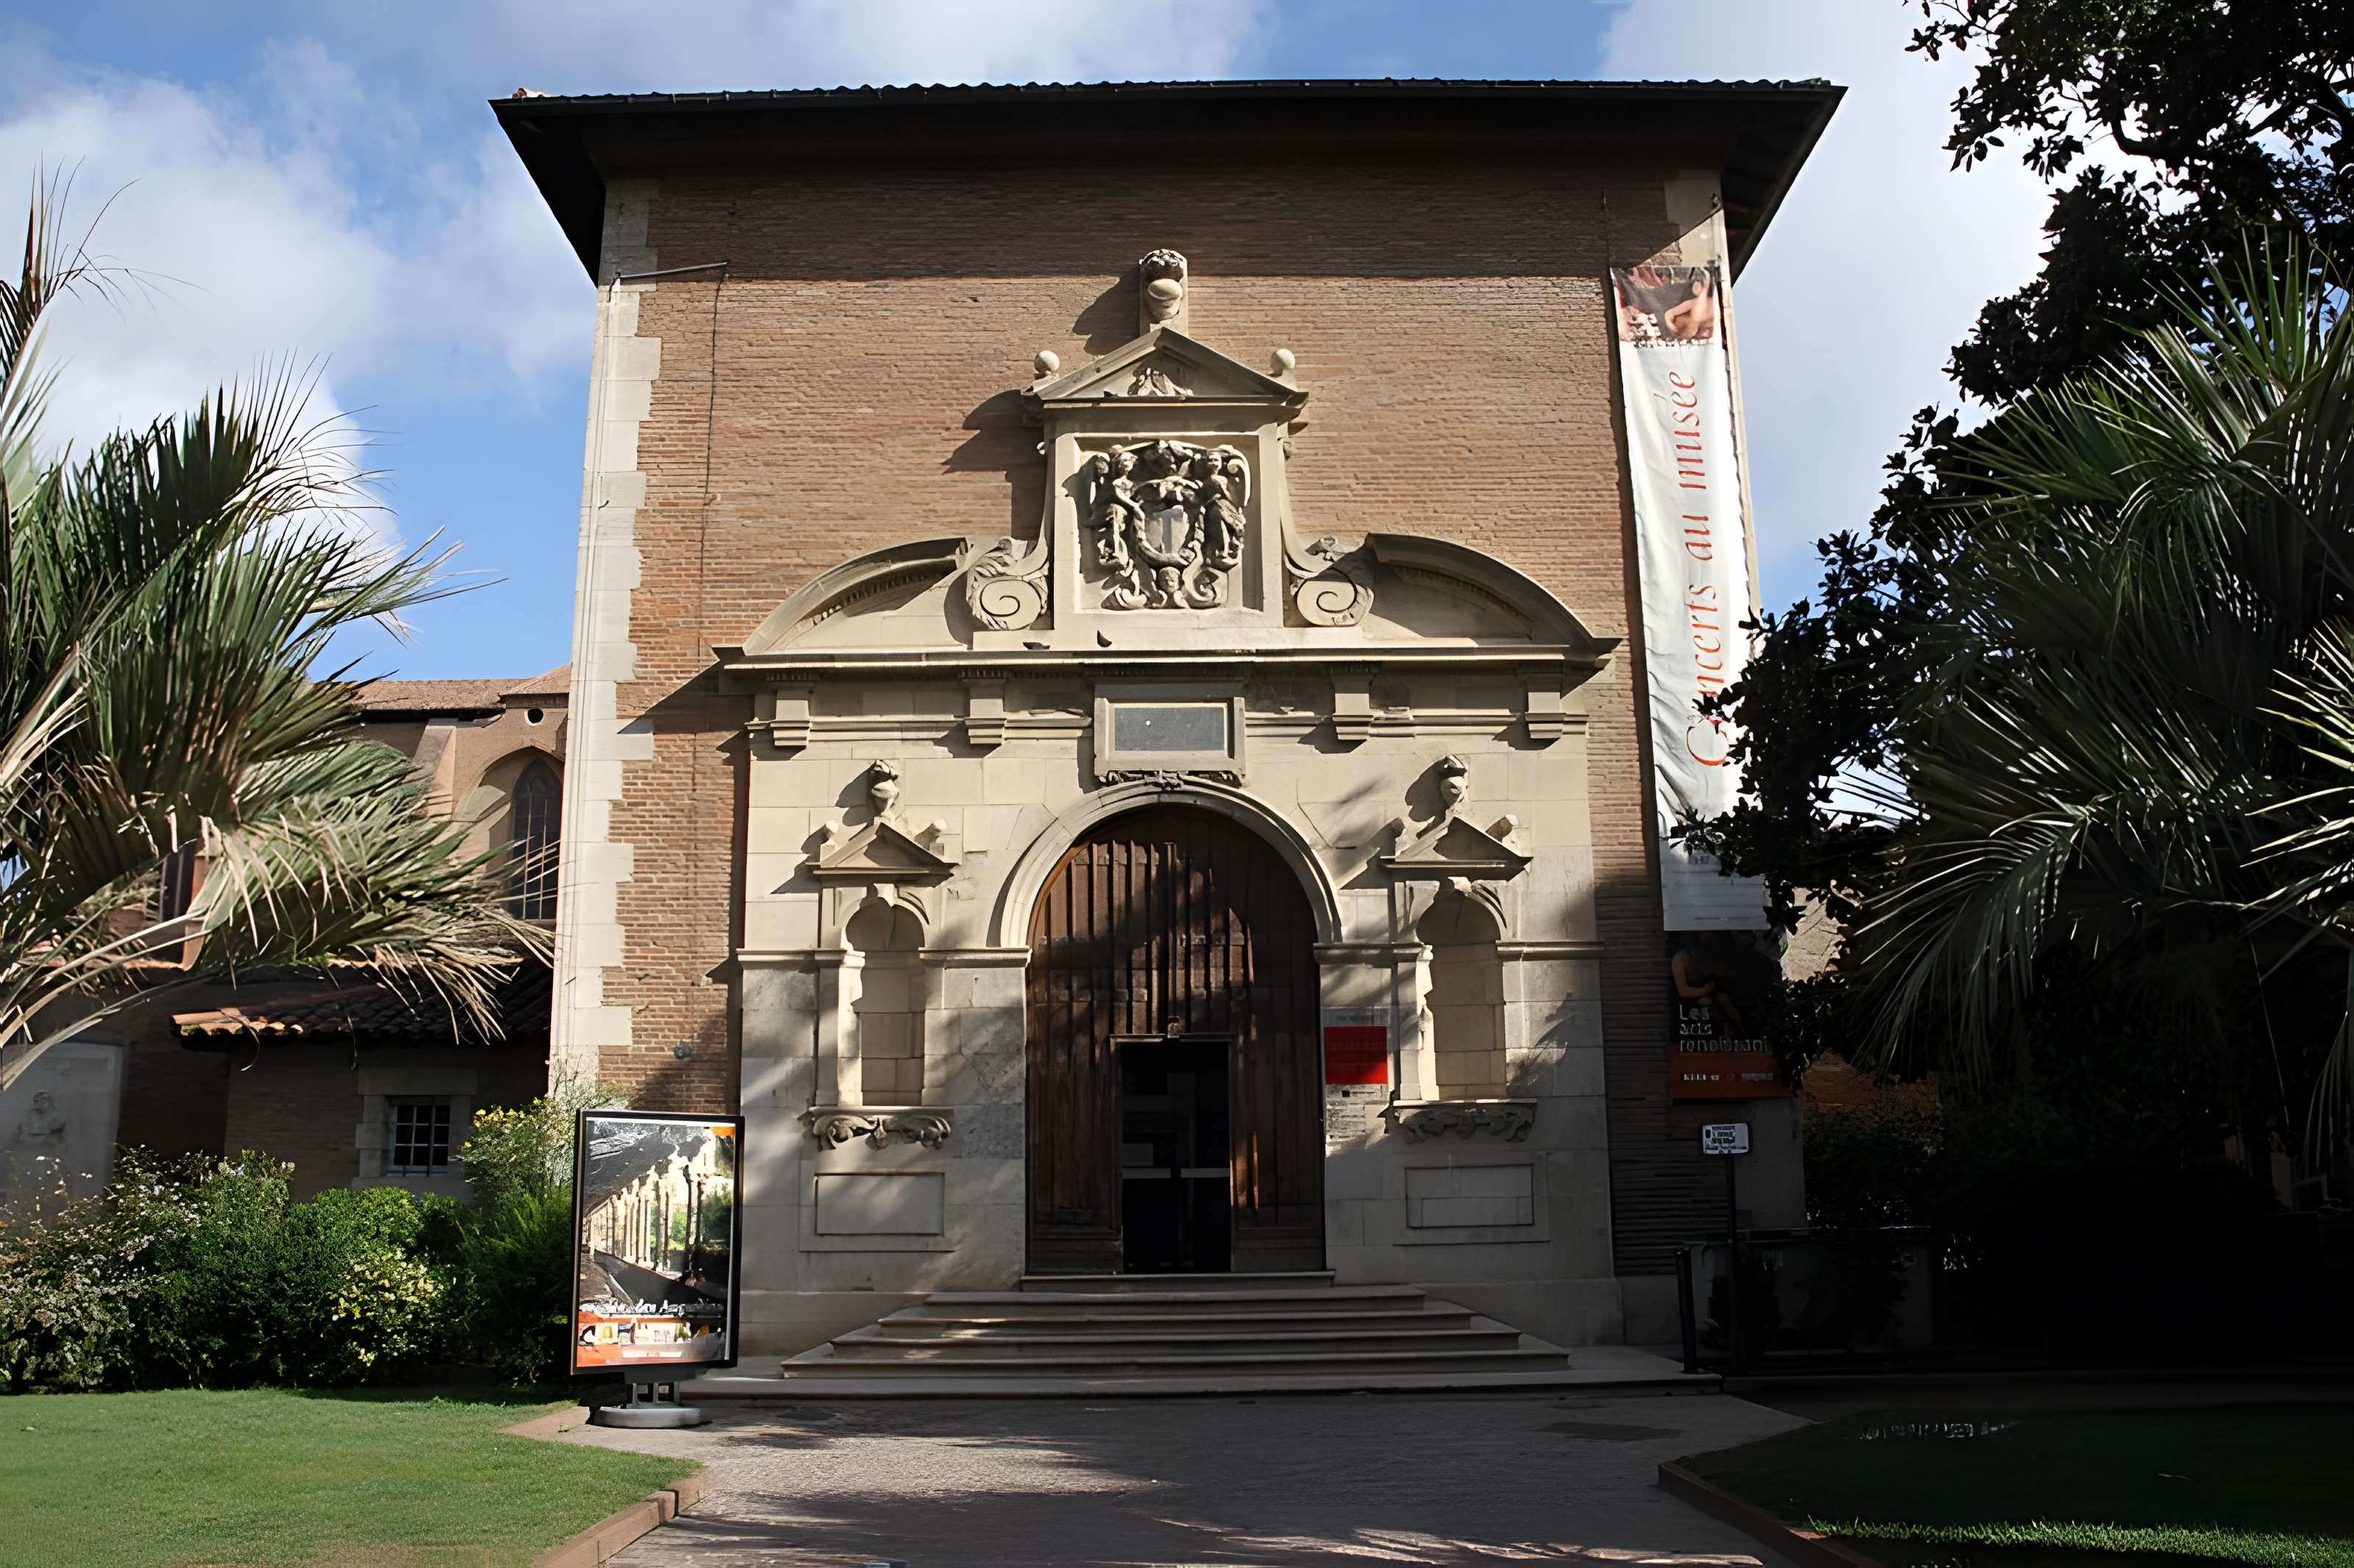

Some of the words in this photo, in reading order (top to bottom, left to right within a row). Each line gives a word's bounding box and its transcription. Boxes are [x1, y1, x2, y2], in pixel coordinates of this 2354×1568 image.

[1682, 514, 1713, 560] au
[1683, 584, 1732, 766] Cncerts
[1678, 1003, 1710, 1021] Les
